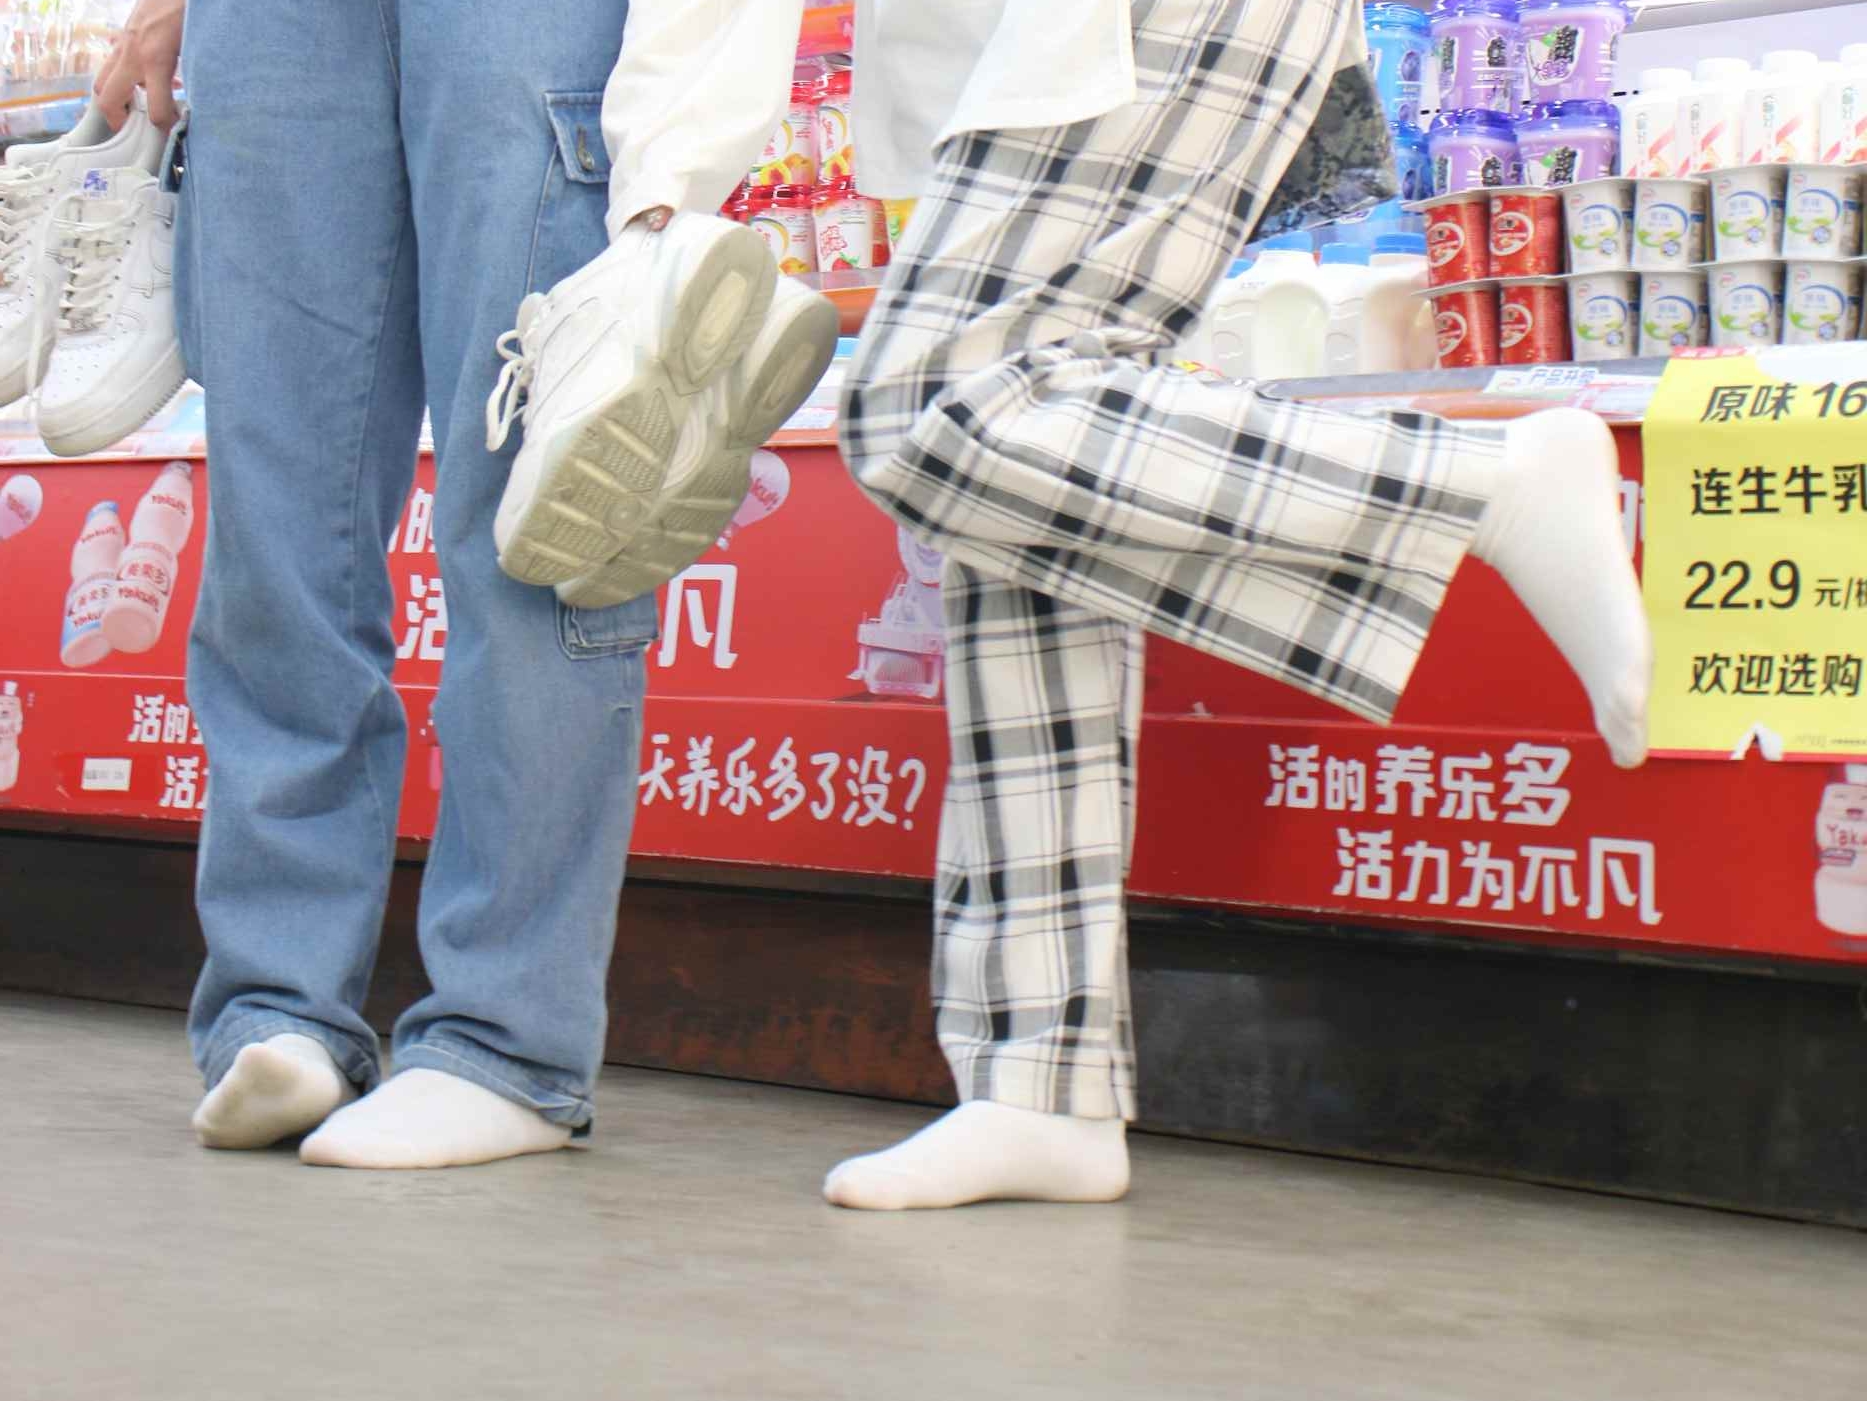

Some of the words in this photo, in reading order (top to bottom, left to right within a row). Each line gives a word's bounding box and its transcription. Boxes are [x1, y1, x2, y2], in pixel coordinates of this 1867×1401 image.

[1700, 382, 1797, 423] 原味
[1685, 559, 1800, 610] 22.9
[1688, 653, 1863, 697] 欢迎选购
[158, 755, 210, 810] 活
[1264, 742, 1572, 827] 活的养乐多
[1332, 826, 1664, 926] 活力为不凡
